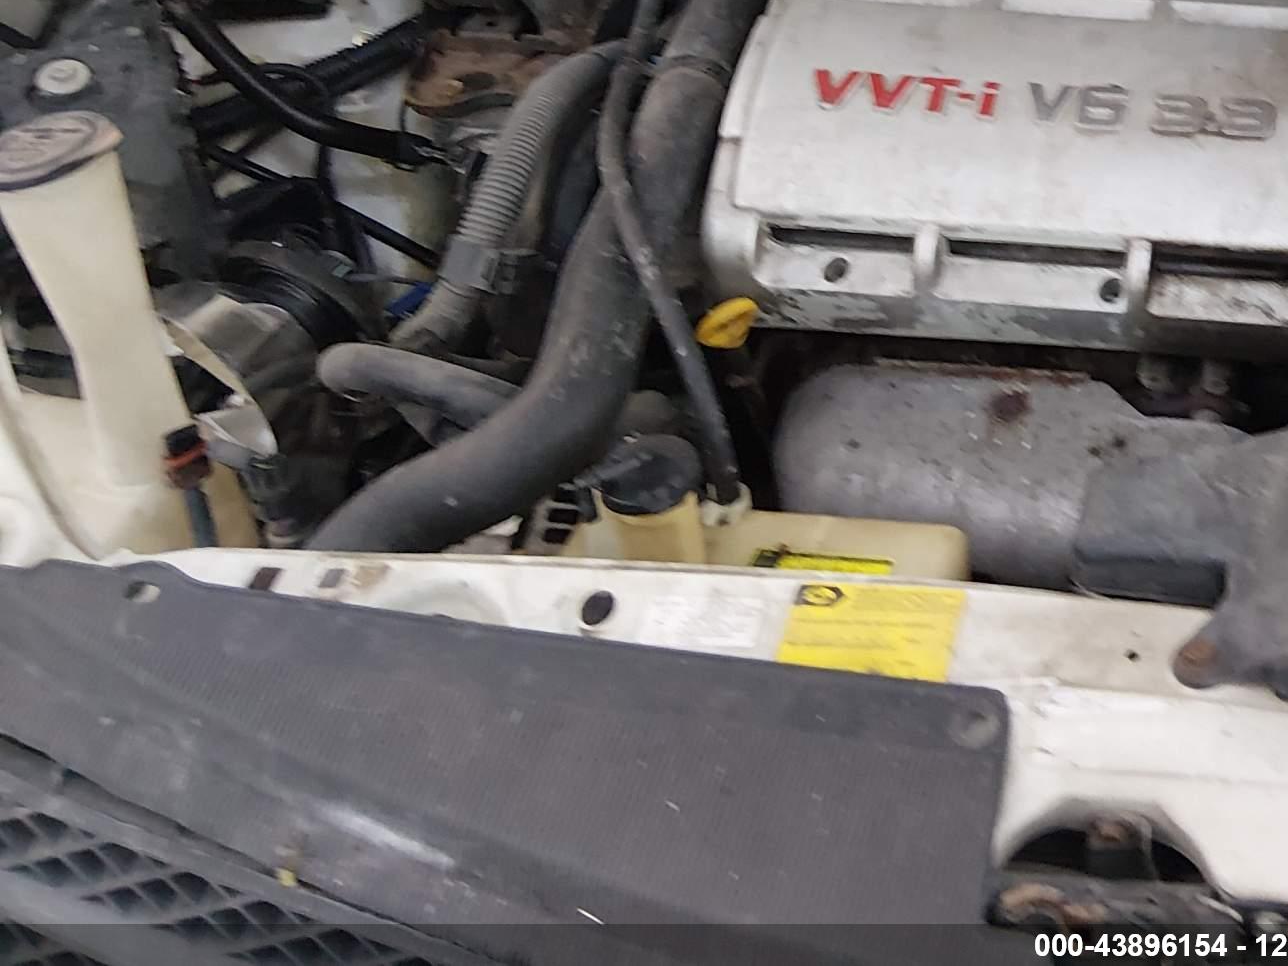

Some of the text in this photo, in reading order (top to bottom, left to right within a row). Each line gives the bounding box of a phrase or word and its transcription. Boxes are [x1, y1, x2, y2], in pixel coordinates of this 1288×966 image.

[814, 68, 1278, 140] VVT-i V6 3.3
